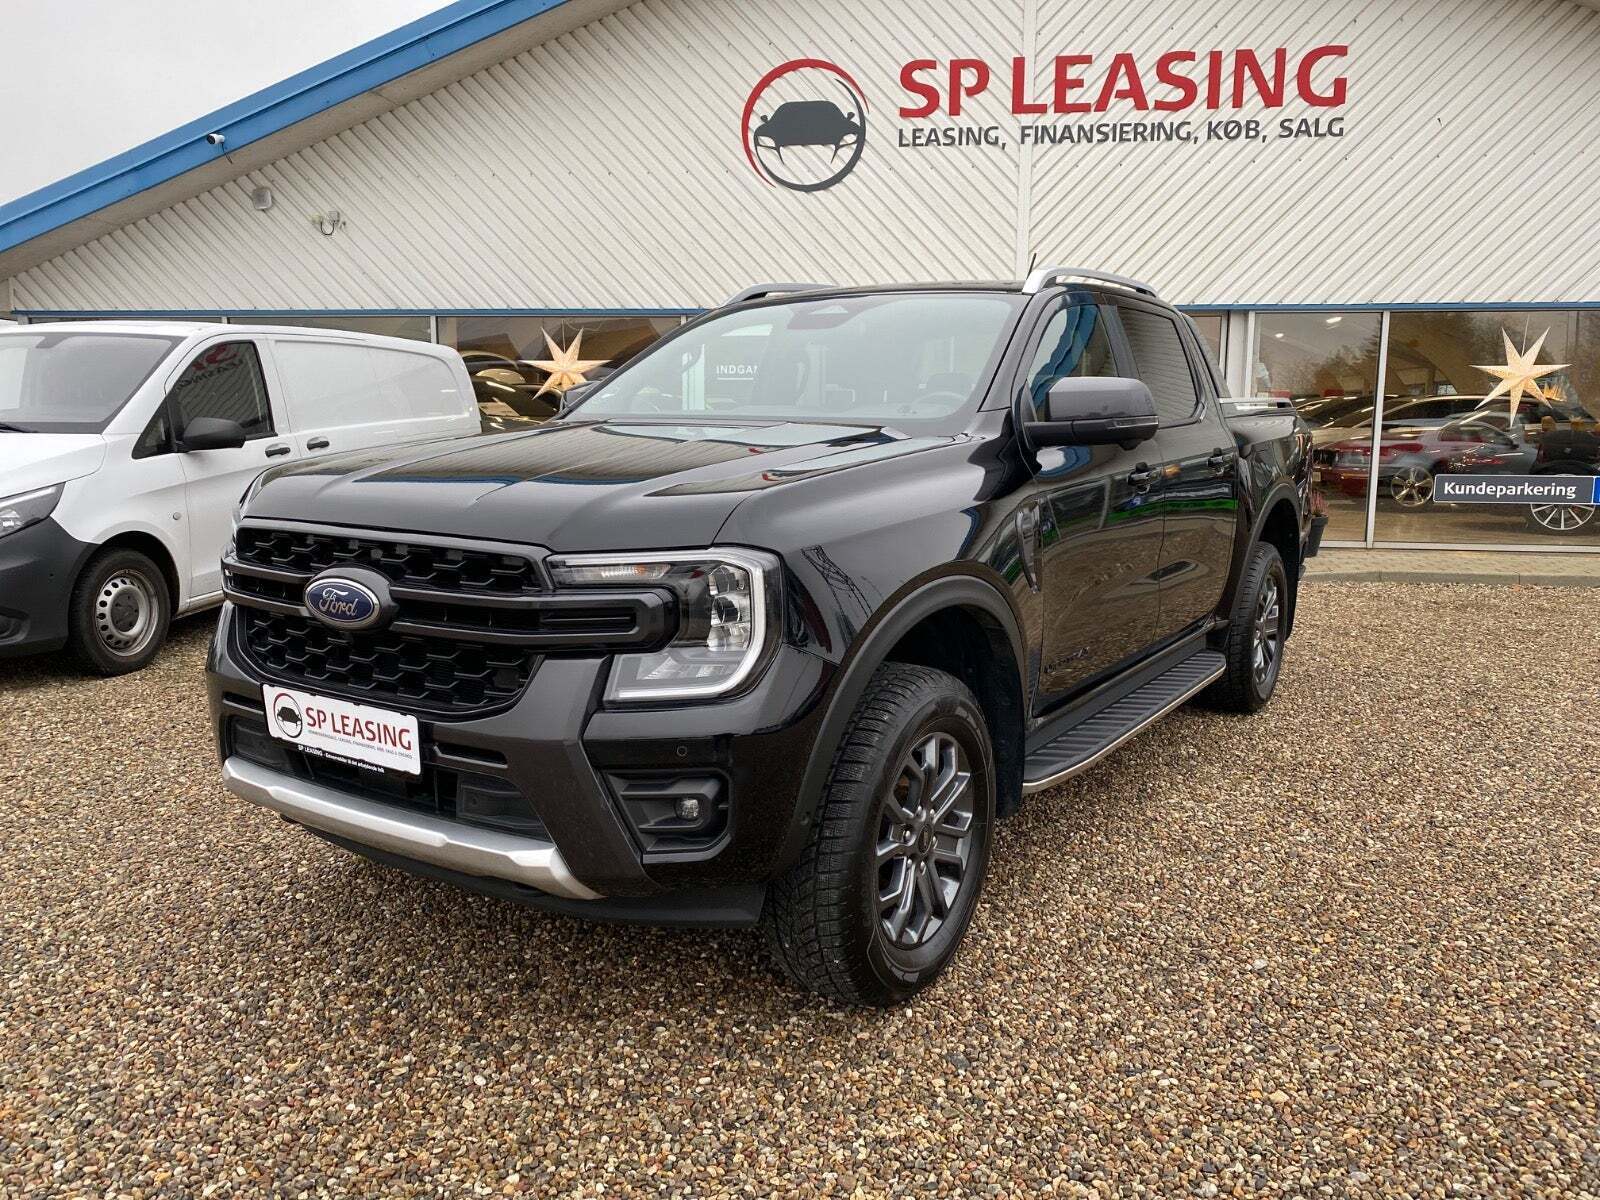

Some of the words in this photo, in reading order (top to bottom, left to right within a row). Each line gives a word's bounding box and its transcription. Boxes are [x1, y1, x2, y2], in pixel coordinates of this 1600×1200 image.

[899, 59, 990, 118] SP
[1011, 45, 1348, 115] LEASING
[898, 126, 1007, 150] LEASING,
[1020, 121, 1198, 145] FINANSIERING,
[1207, 119, 1267, 143] KØB,
[1278, 116, 1345, 139] SALG
[1439, 477, 1566, 499] Kundeparkering
[319, 587, 359, 616] Ford
[305, 706, 327, 729] SP
[331, 712, 412, 750] LEASING
